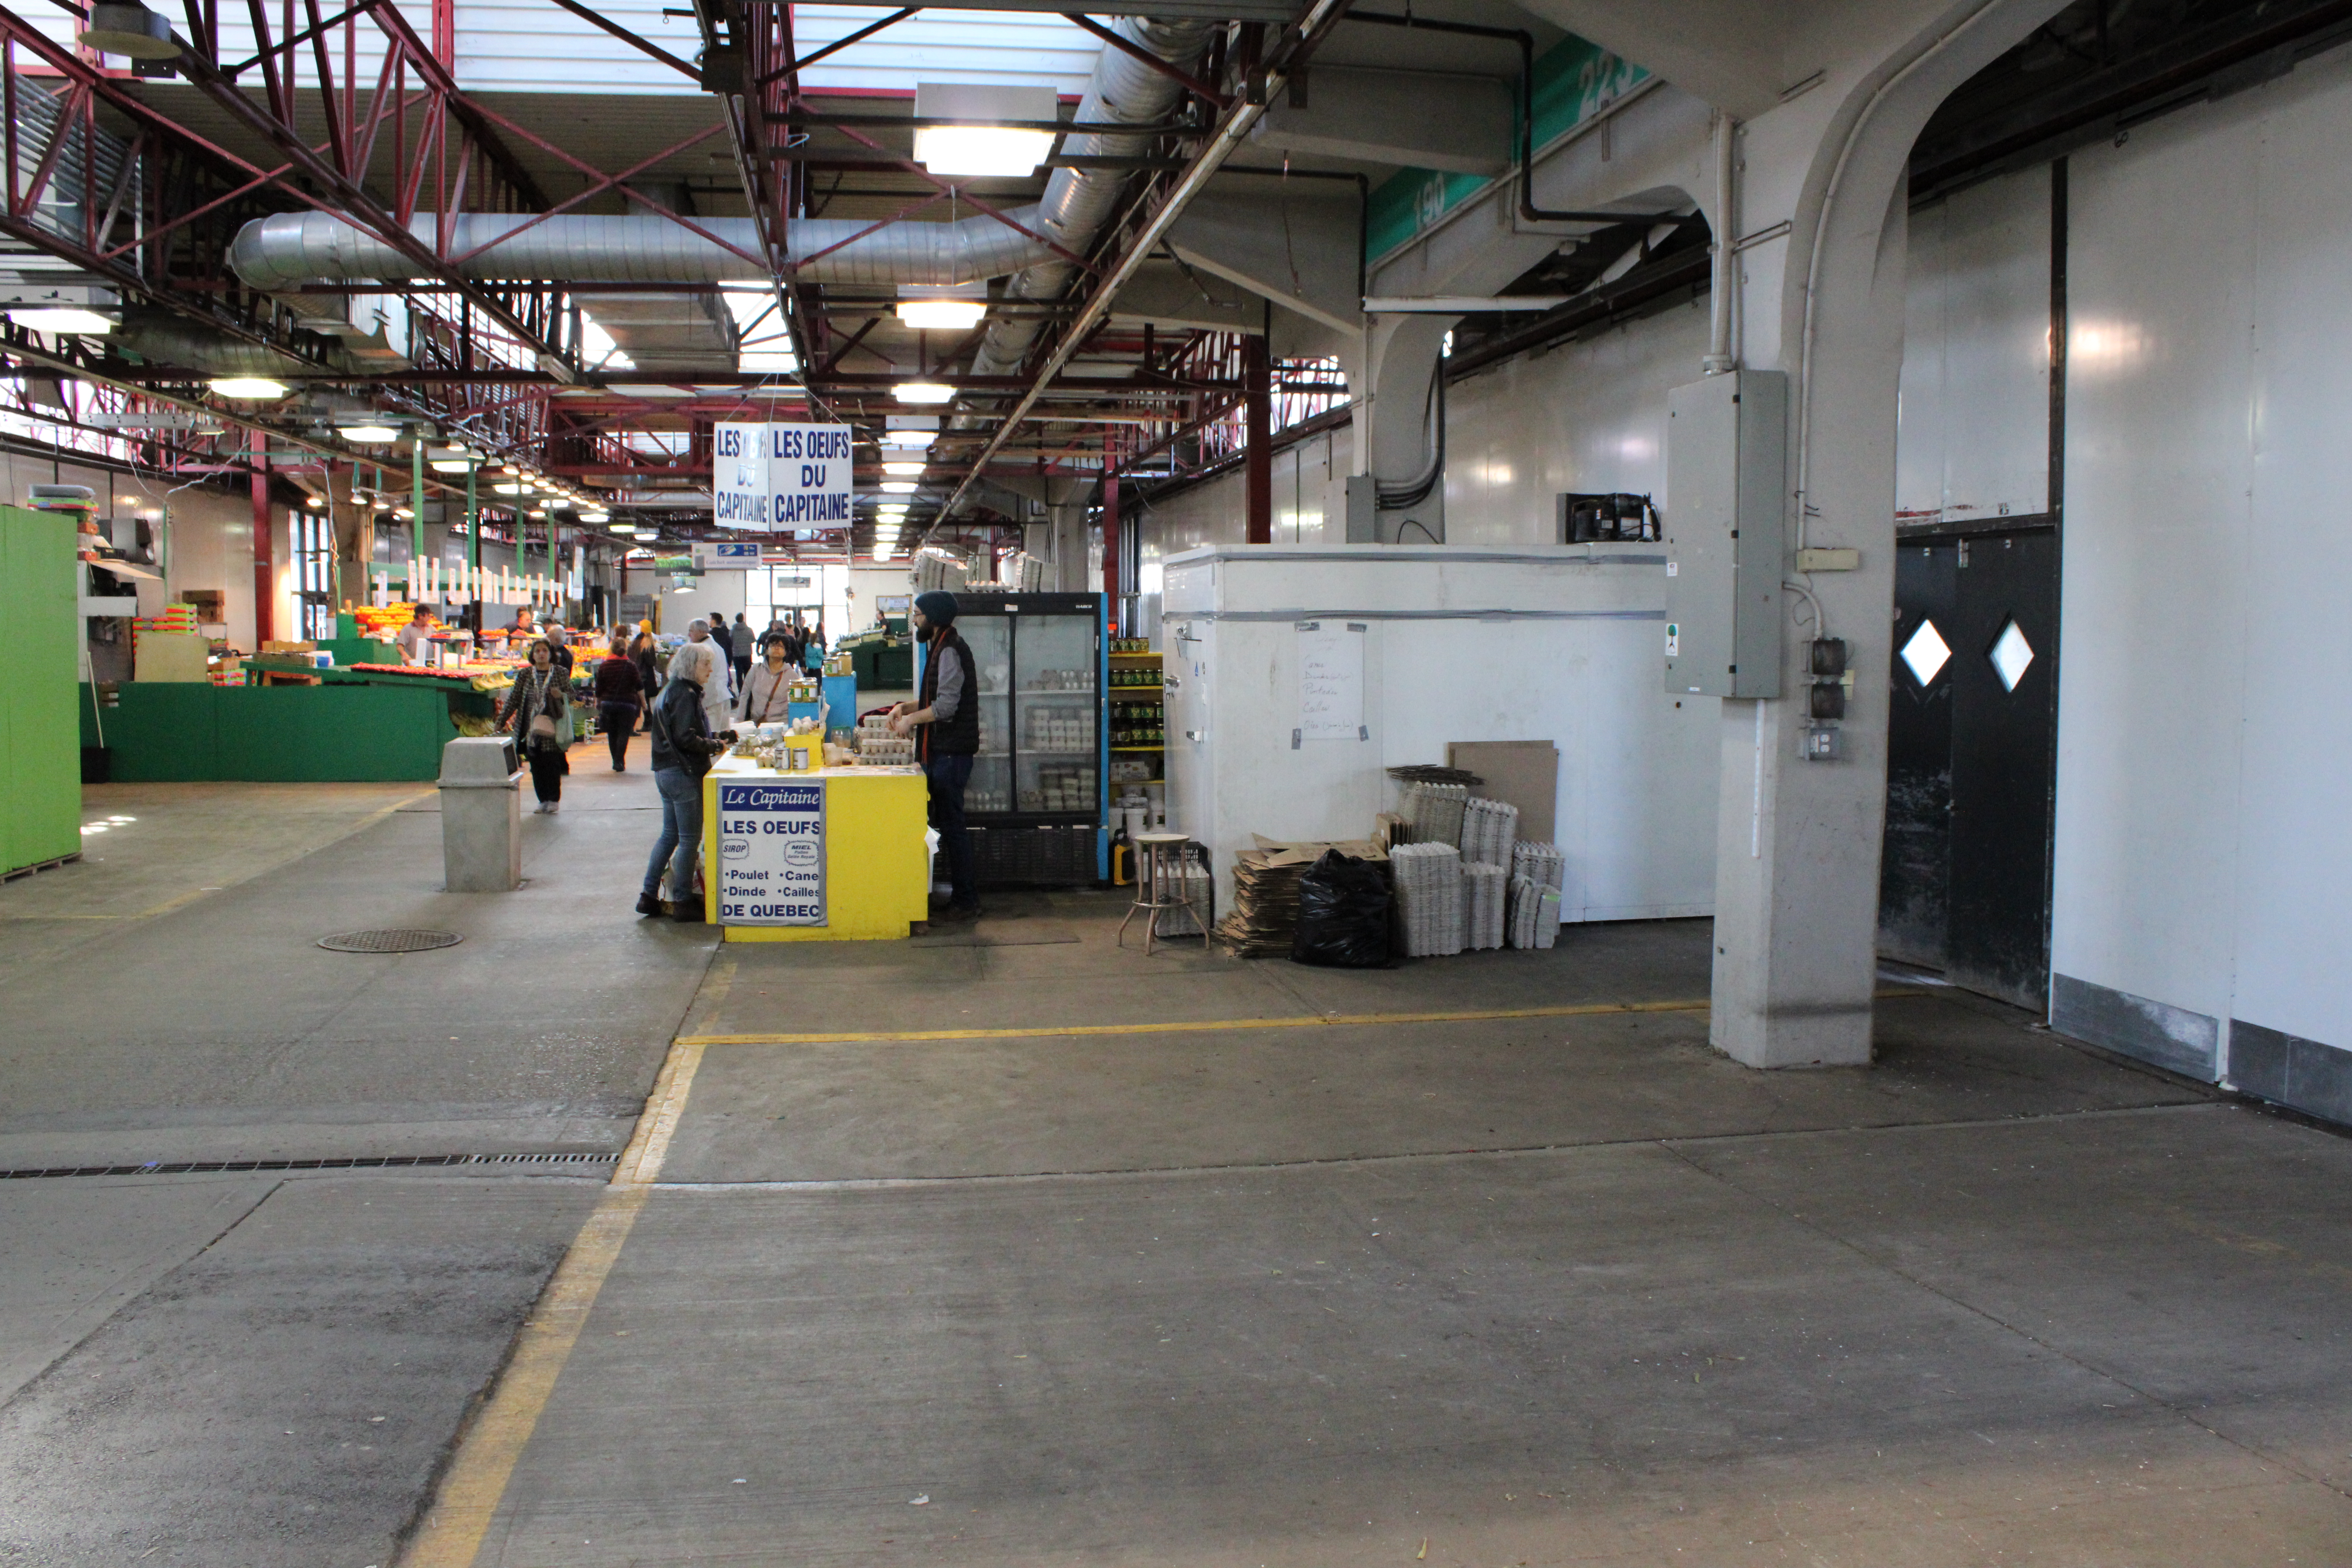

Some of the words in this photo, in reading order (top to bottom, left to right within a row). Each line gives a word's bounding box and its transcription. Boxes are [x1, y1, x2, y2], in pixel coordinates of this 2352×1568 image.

[1414, 171, 1445, 232] 190
[718, 429, 740, 457] LES
[774, 430, 802, 459] LES
[807, 431, 849, 459] OEUFS
[738, 463, 756, 487] DU
[802, 465, 826, 487] DU
[717, 490, 767, 523] CAPITAINE
[775, 493, 849, 523] CAPITAINE
[724, 789, 745, 804] Le
[750, 789, 819, 809] Capitaine
[724, 820, 757, 834] LES
[763, 820, 820, 835] OEUFS
[731, 870, 769, 880] Poulet
[785, 870, 819, 880] Cane
[729, 886, 766, 896] Dinde
[723, 904, 744, 916] DE
[750, 904, 819, 917] QUEBEC
